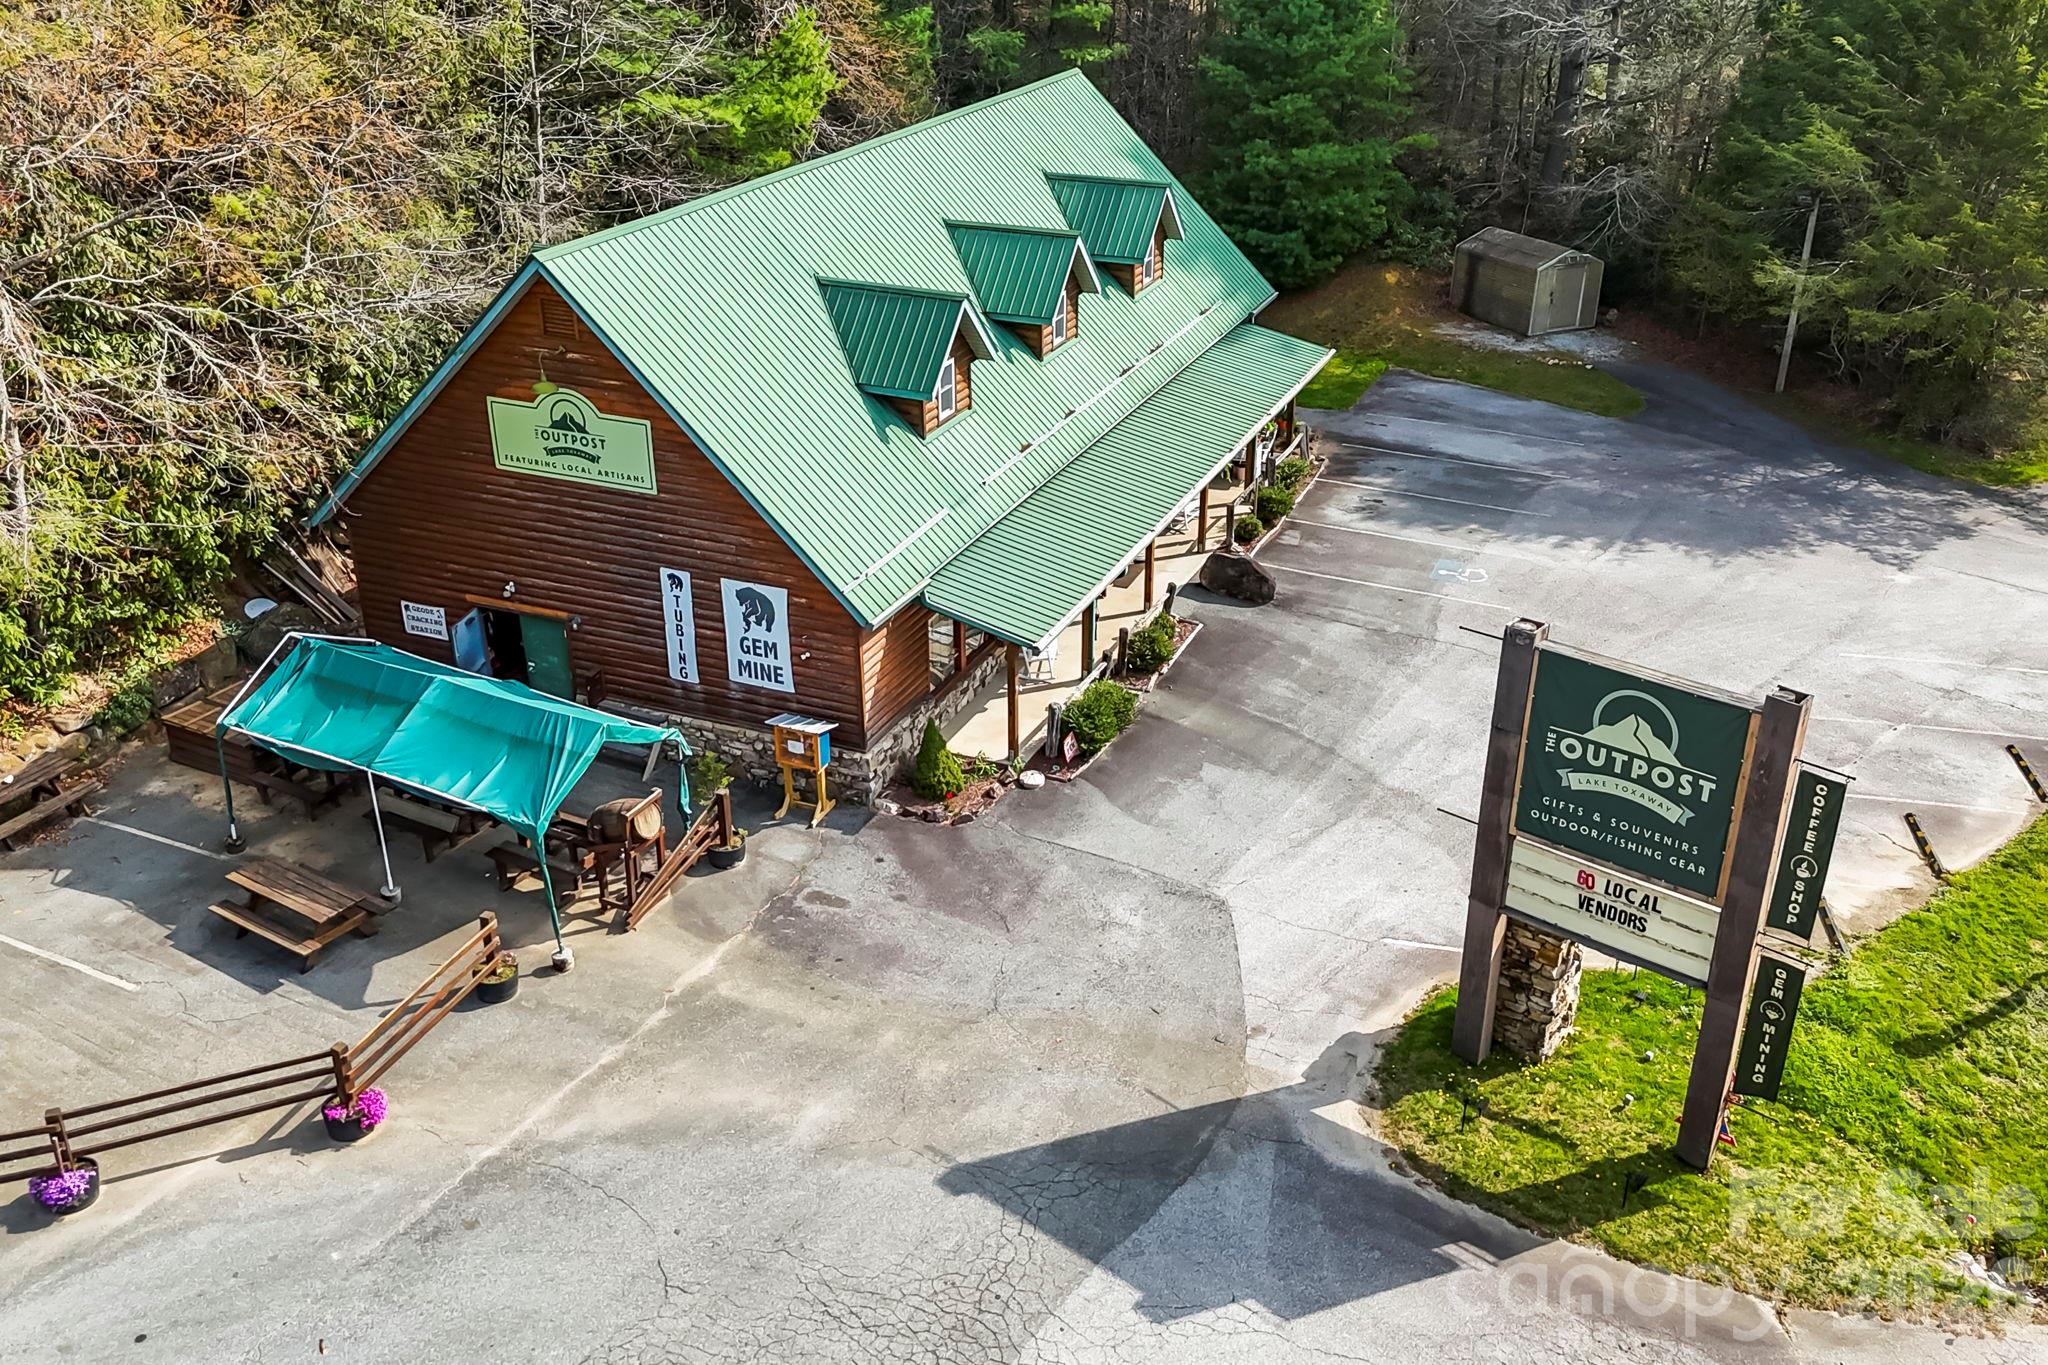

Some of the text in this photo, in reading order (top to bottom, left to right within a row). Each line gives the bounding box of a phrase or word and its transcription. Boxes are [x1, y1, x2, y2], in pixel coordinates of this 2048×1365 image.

[540, 429, 606, 450] OUTPOST
[504, 454, 646, 484] FEATURING LOCAL ARTISANS
[406, 614, 443, 626] CRACKING
[411, 605, 435, 615] GEODE
[411, 624, 443, 636] STATION
[673, 595, 688, 679] TUBING
[739, 636, 778, 660] GEM
[737, 658, 785, 685] MINE
[1545, 731, 1557, 753] THE
[1559, 737, 1717, 803] OUTPOST
[1578, 777, 1673, 813] LAKE TOXAWAY
[1530, 809, 1706, 876] OUTDOOR/FISHING GEAR
[1542, 796, 1699, 855] GIFTS & SOUVENIRS
[1786, 784, 1828, 925] COFFEE SHOP
[1577, 869, 1662, 914] 60 LOCAL
[1578, 893, 1648, 933] VENDORS
[1752, 968, 1787, 1083] GEM MINING
